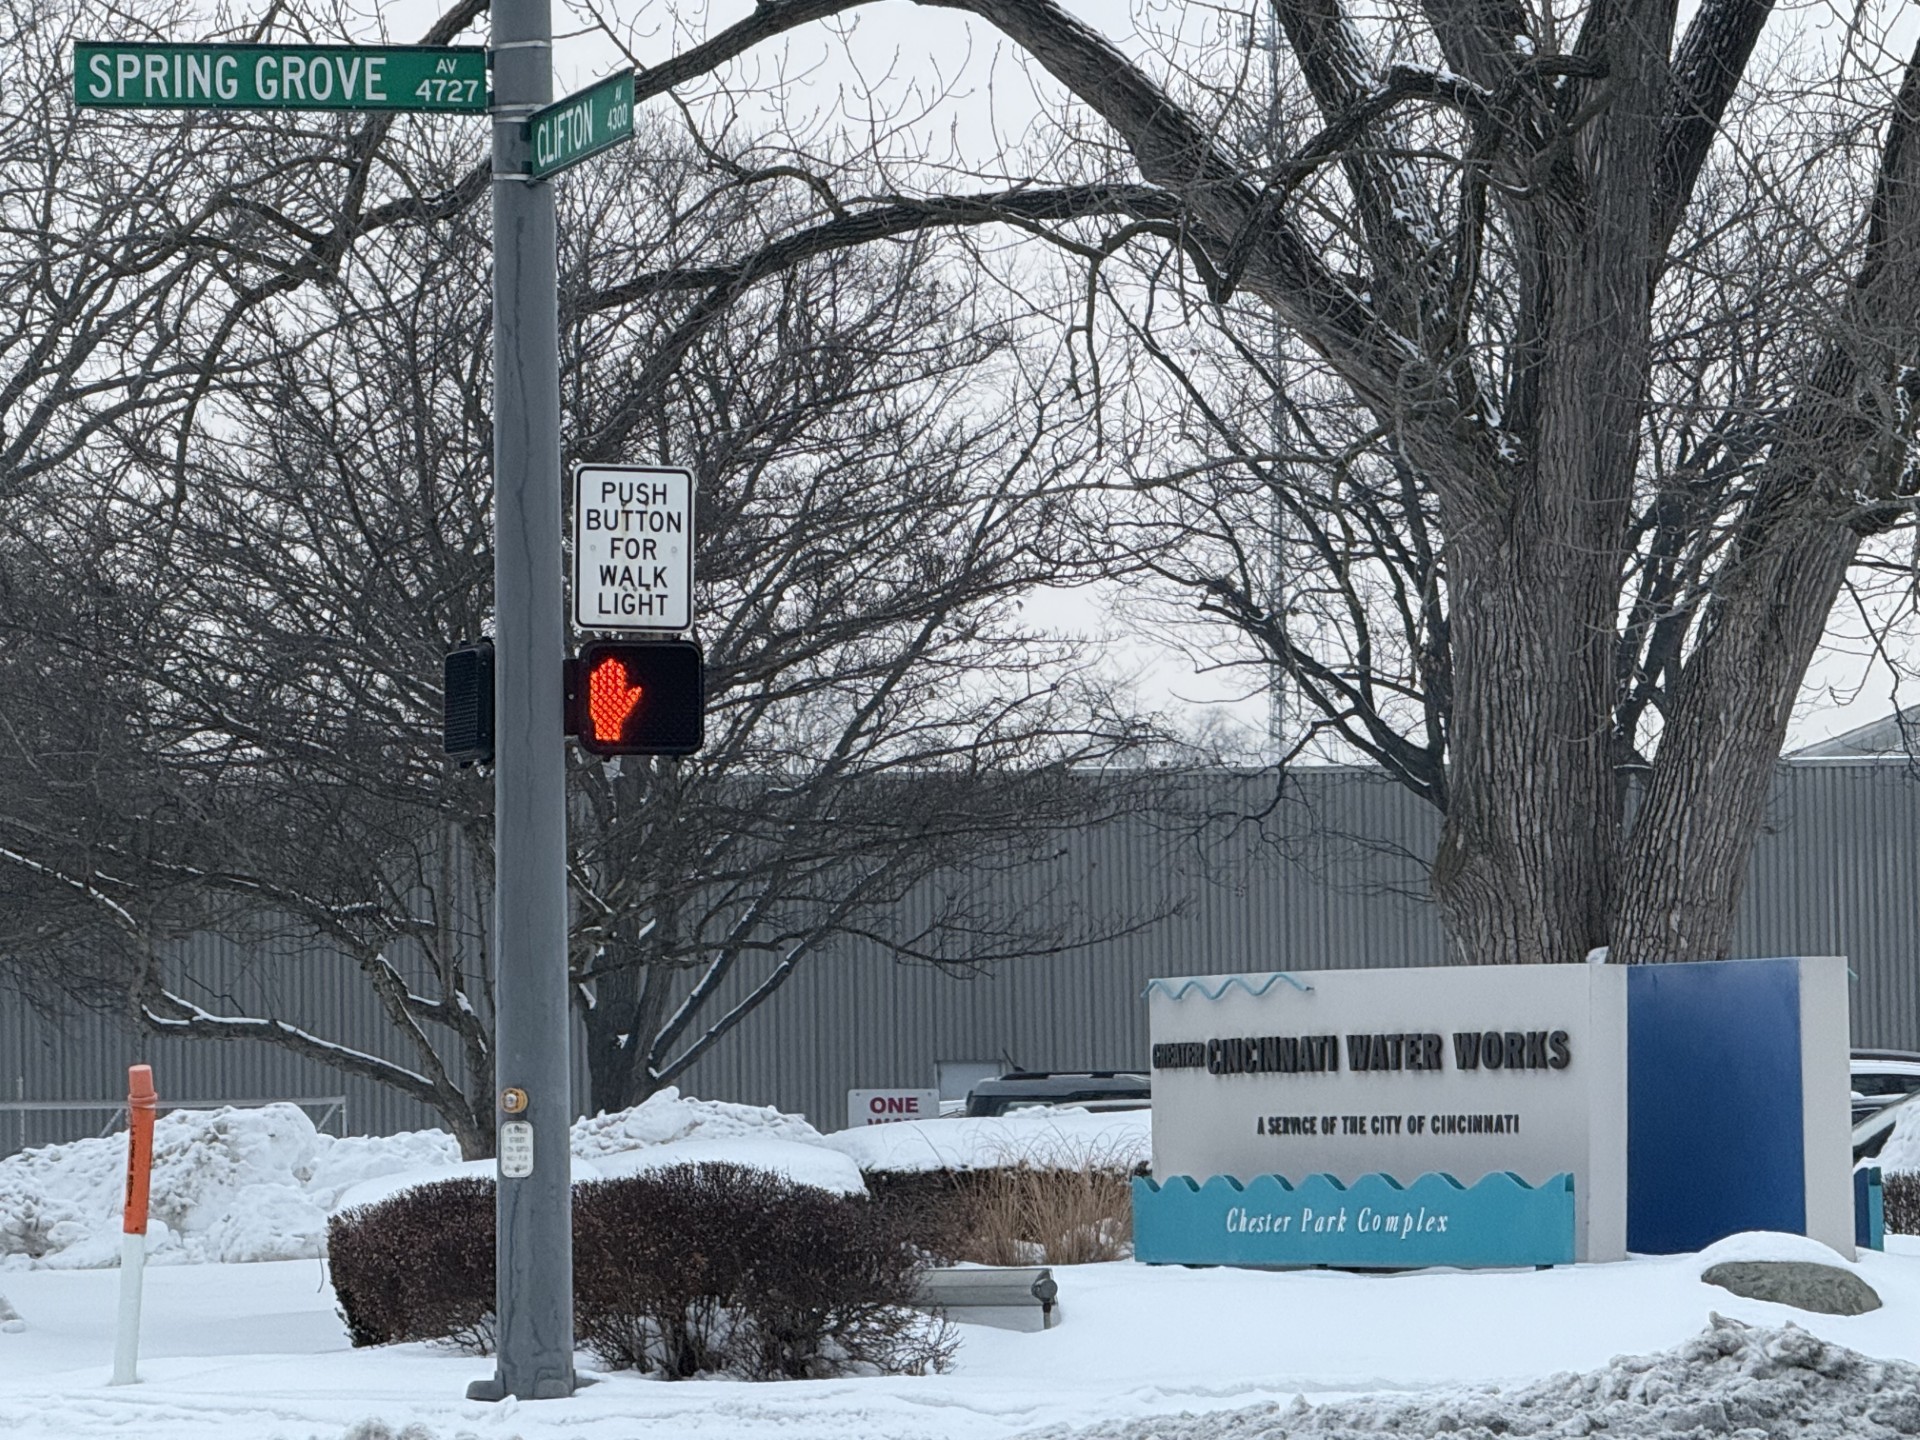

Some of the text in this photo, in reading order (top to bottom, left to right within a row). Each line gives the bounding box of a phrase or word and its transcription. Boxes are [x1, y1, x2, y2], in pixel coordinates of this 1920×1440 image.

[89, 53, 387, 101] SPRING GROVE
[436, 58, 457, 74] AV
[415, 79, 479, 102] 4727
[607, 102, 628, 131] 4300
[537, 98, 593, 168] CLIFTON
[601, 482, 667, 505] PUSH
[586, 509, 682, 533] BUTTON
[610, 537, 657, 561] FOR
[600, 565, 668, 589] WALK
[598, 592, 668, 616] LIGHT
[1152, 1030, 1571, 1074] GREATER CINCINNATI WATER WORKS
[869, 1096, 919, 1114] ONE
[1257, 1113, 1520, 1135] A SERVICE OF THE CITY OF CINCINNATI
[1226, 1206, 1449, 1240] Chester Park Complex
